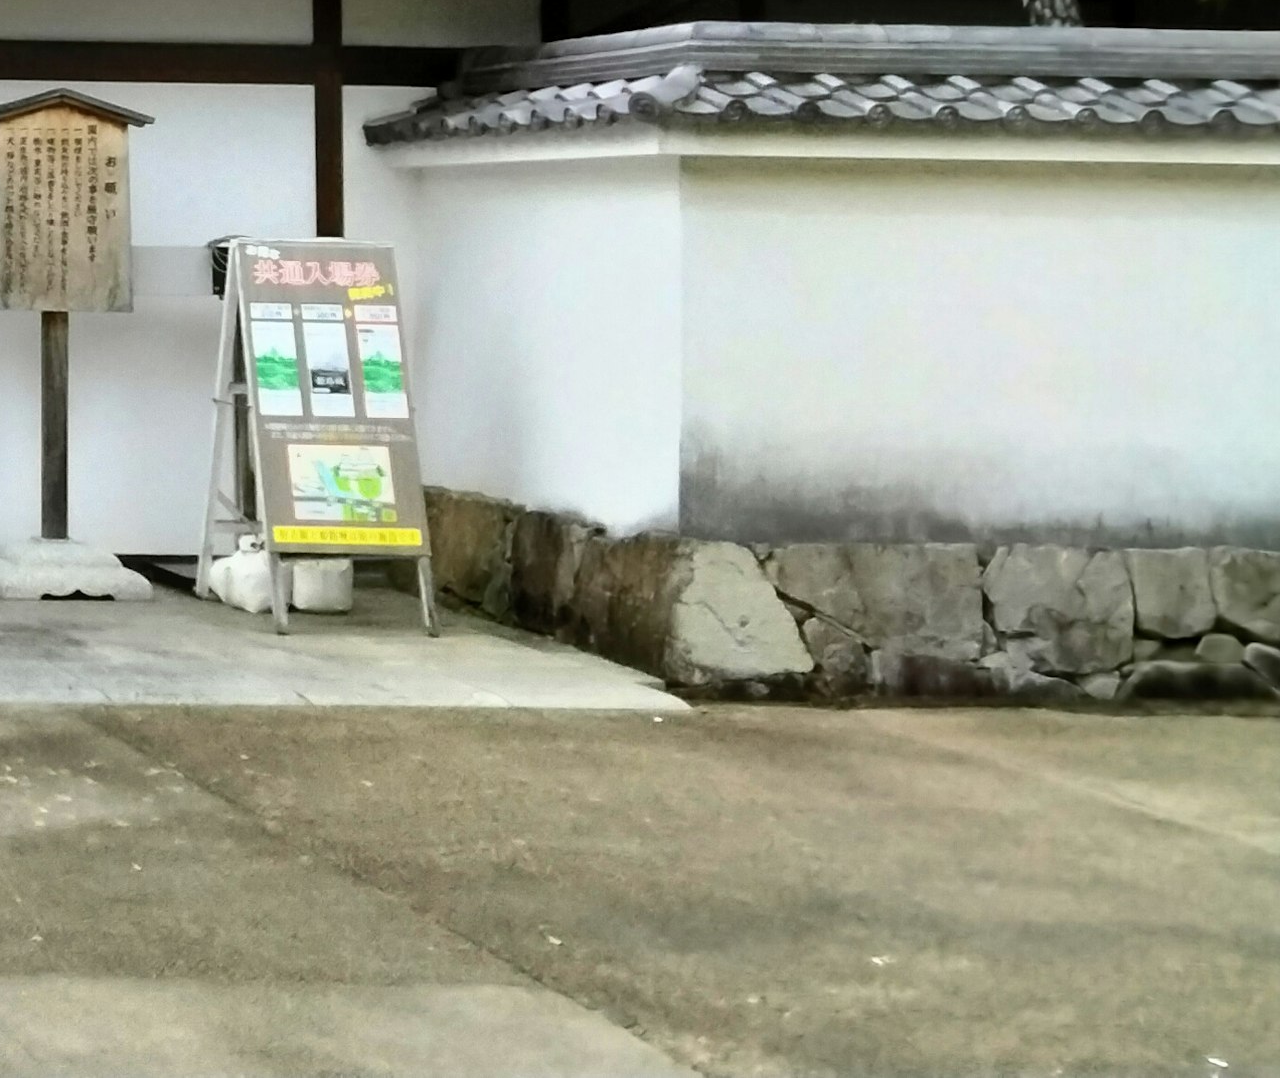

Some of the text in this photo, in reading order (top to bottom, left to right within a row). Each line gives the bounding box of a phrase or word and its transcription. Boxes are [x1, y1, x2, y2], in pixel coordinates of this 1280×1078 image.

[253, 259, 380, 287] 共通入場券
